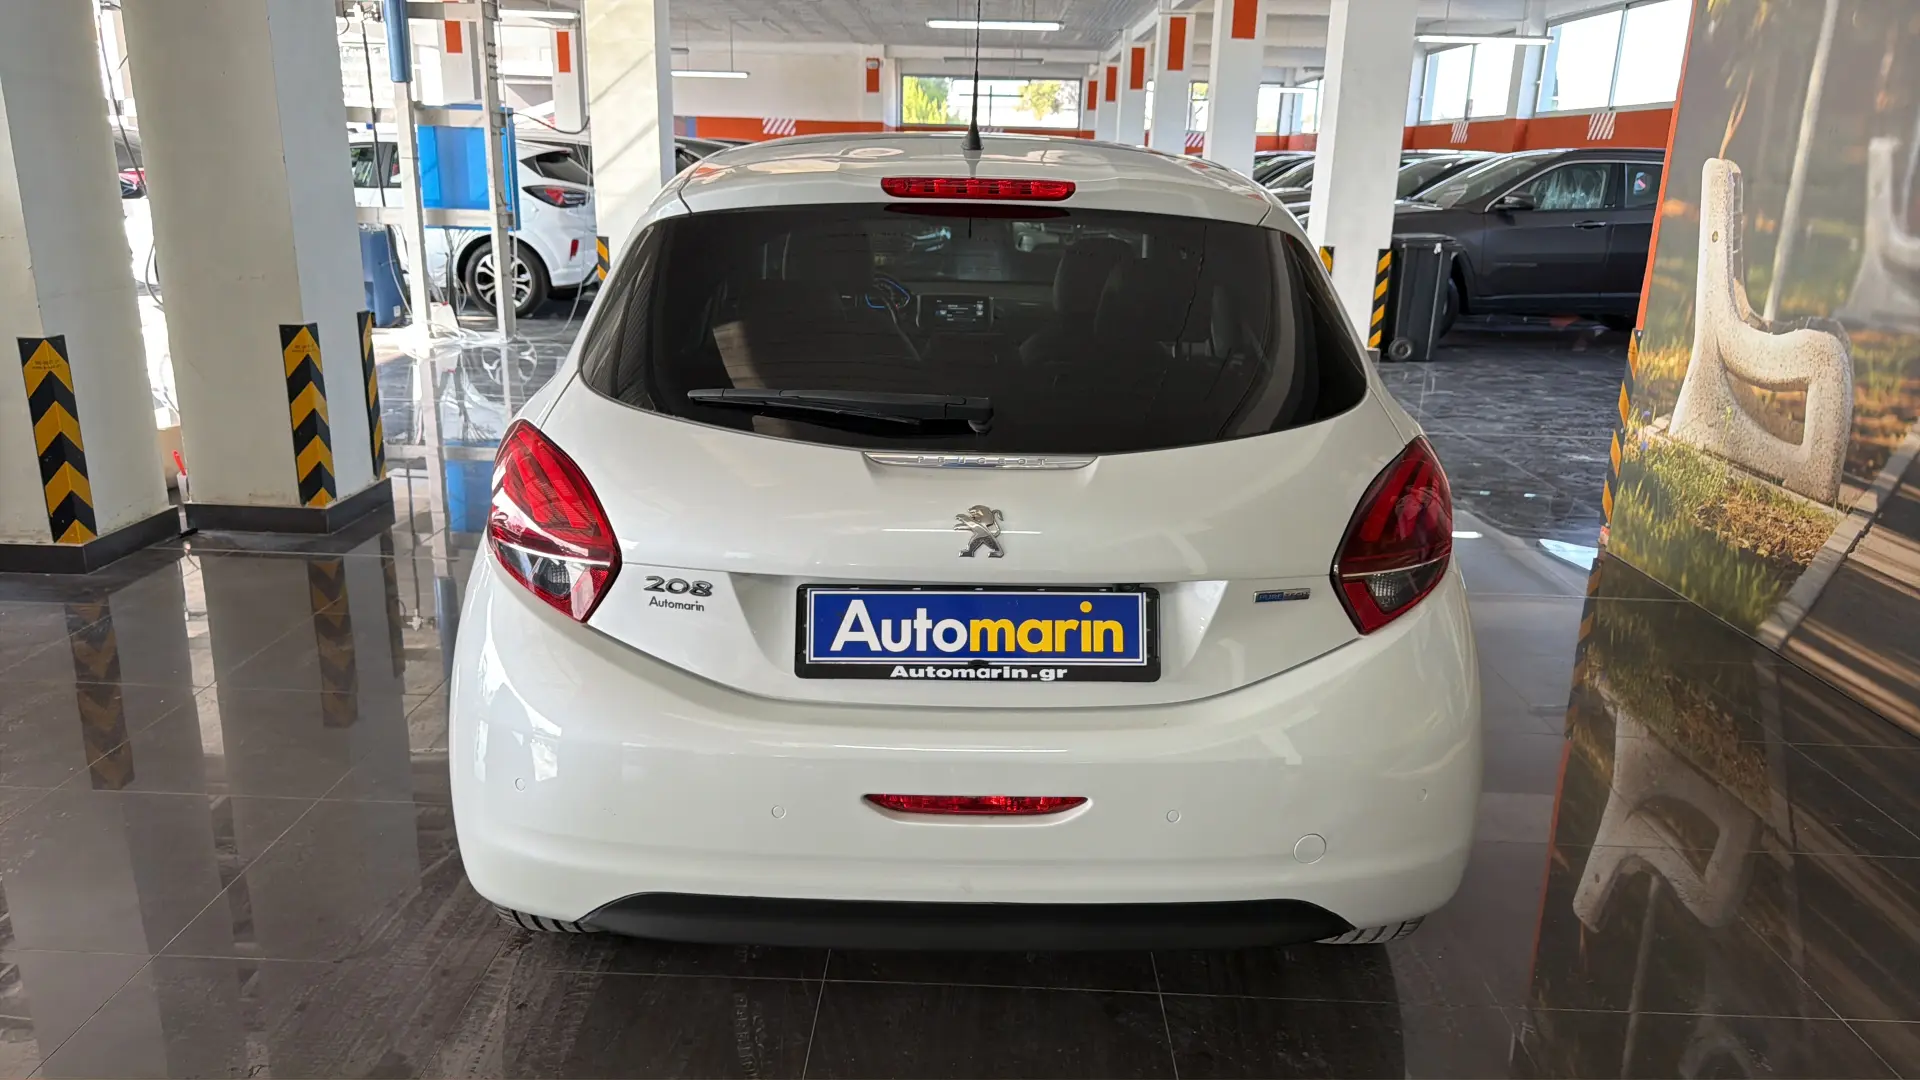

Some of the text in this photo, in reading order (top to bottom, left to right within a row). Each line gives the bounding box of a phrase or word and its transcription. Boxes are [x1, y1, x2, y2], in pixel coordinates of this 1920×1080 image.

[917, 456, 1047, 466] PEUGEOT
[643, 576, 713, 597] 208
[649, 596, 705, 611] Automarin
[830, 599, 1124, 653] Automarin
[890, 666, 1068, 681] Automarin.gr
